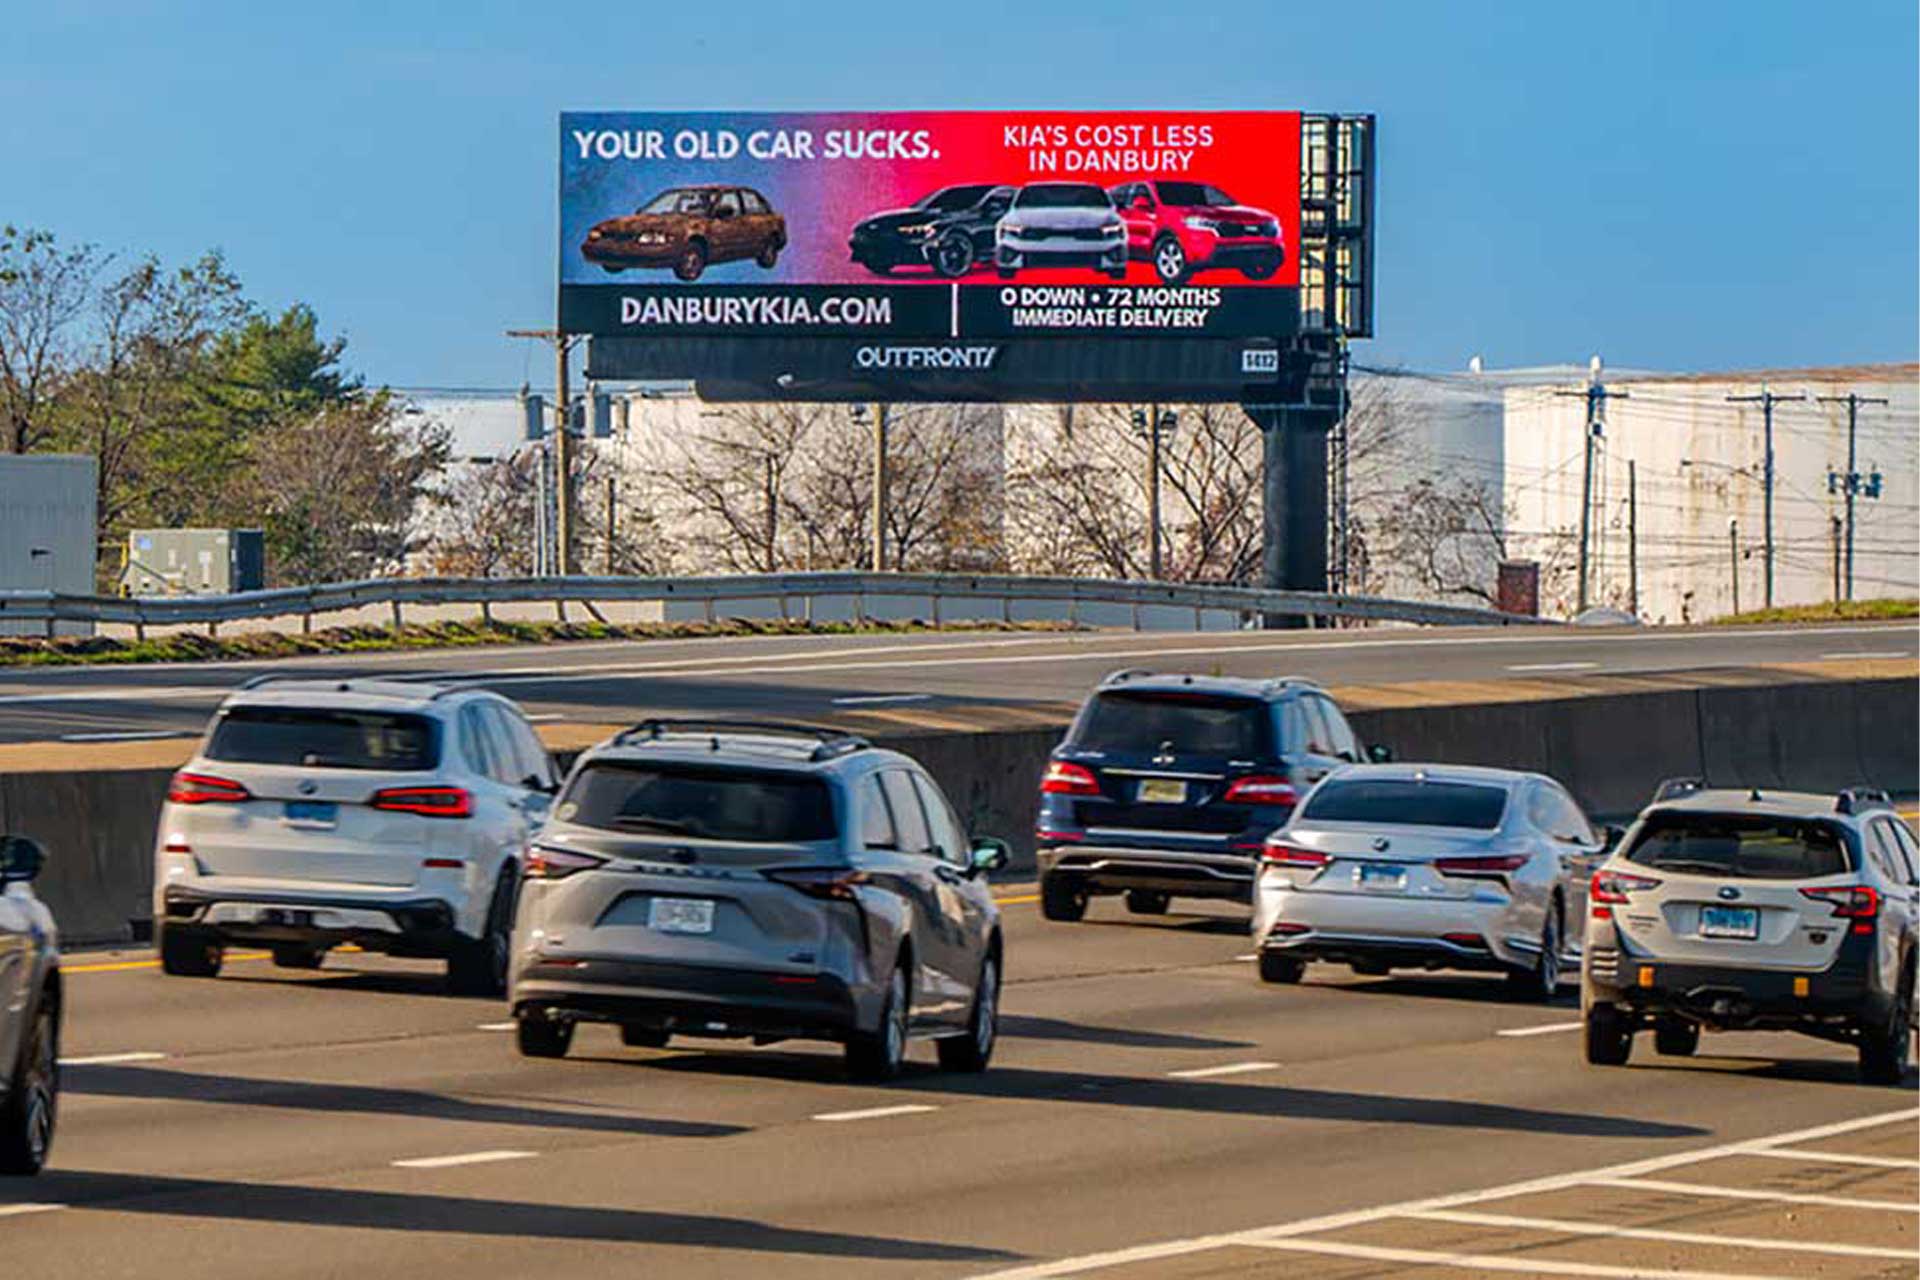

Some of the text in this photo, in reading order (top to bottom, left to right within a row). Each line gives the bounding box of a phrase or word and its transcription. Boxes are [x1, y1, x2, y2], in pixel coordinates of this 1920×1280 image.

[573, 130, 940, 160] YOUR OLD CAR SUCKS.
[1003, 125, 1213, 147] KIA'S COST LESS
[1029, 150, 1194, 172] IN DANBURY
[1021, 288, 1085, 305] DOWN
[1108, 288, 1132, 305] 72
[1136, 288, 1220, 306] MONTHS
[621, 297, 892, 324] DANBURYKIA.COM
[1013, 308, 1208, 327] IMMEDIATE DELIVERY
